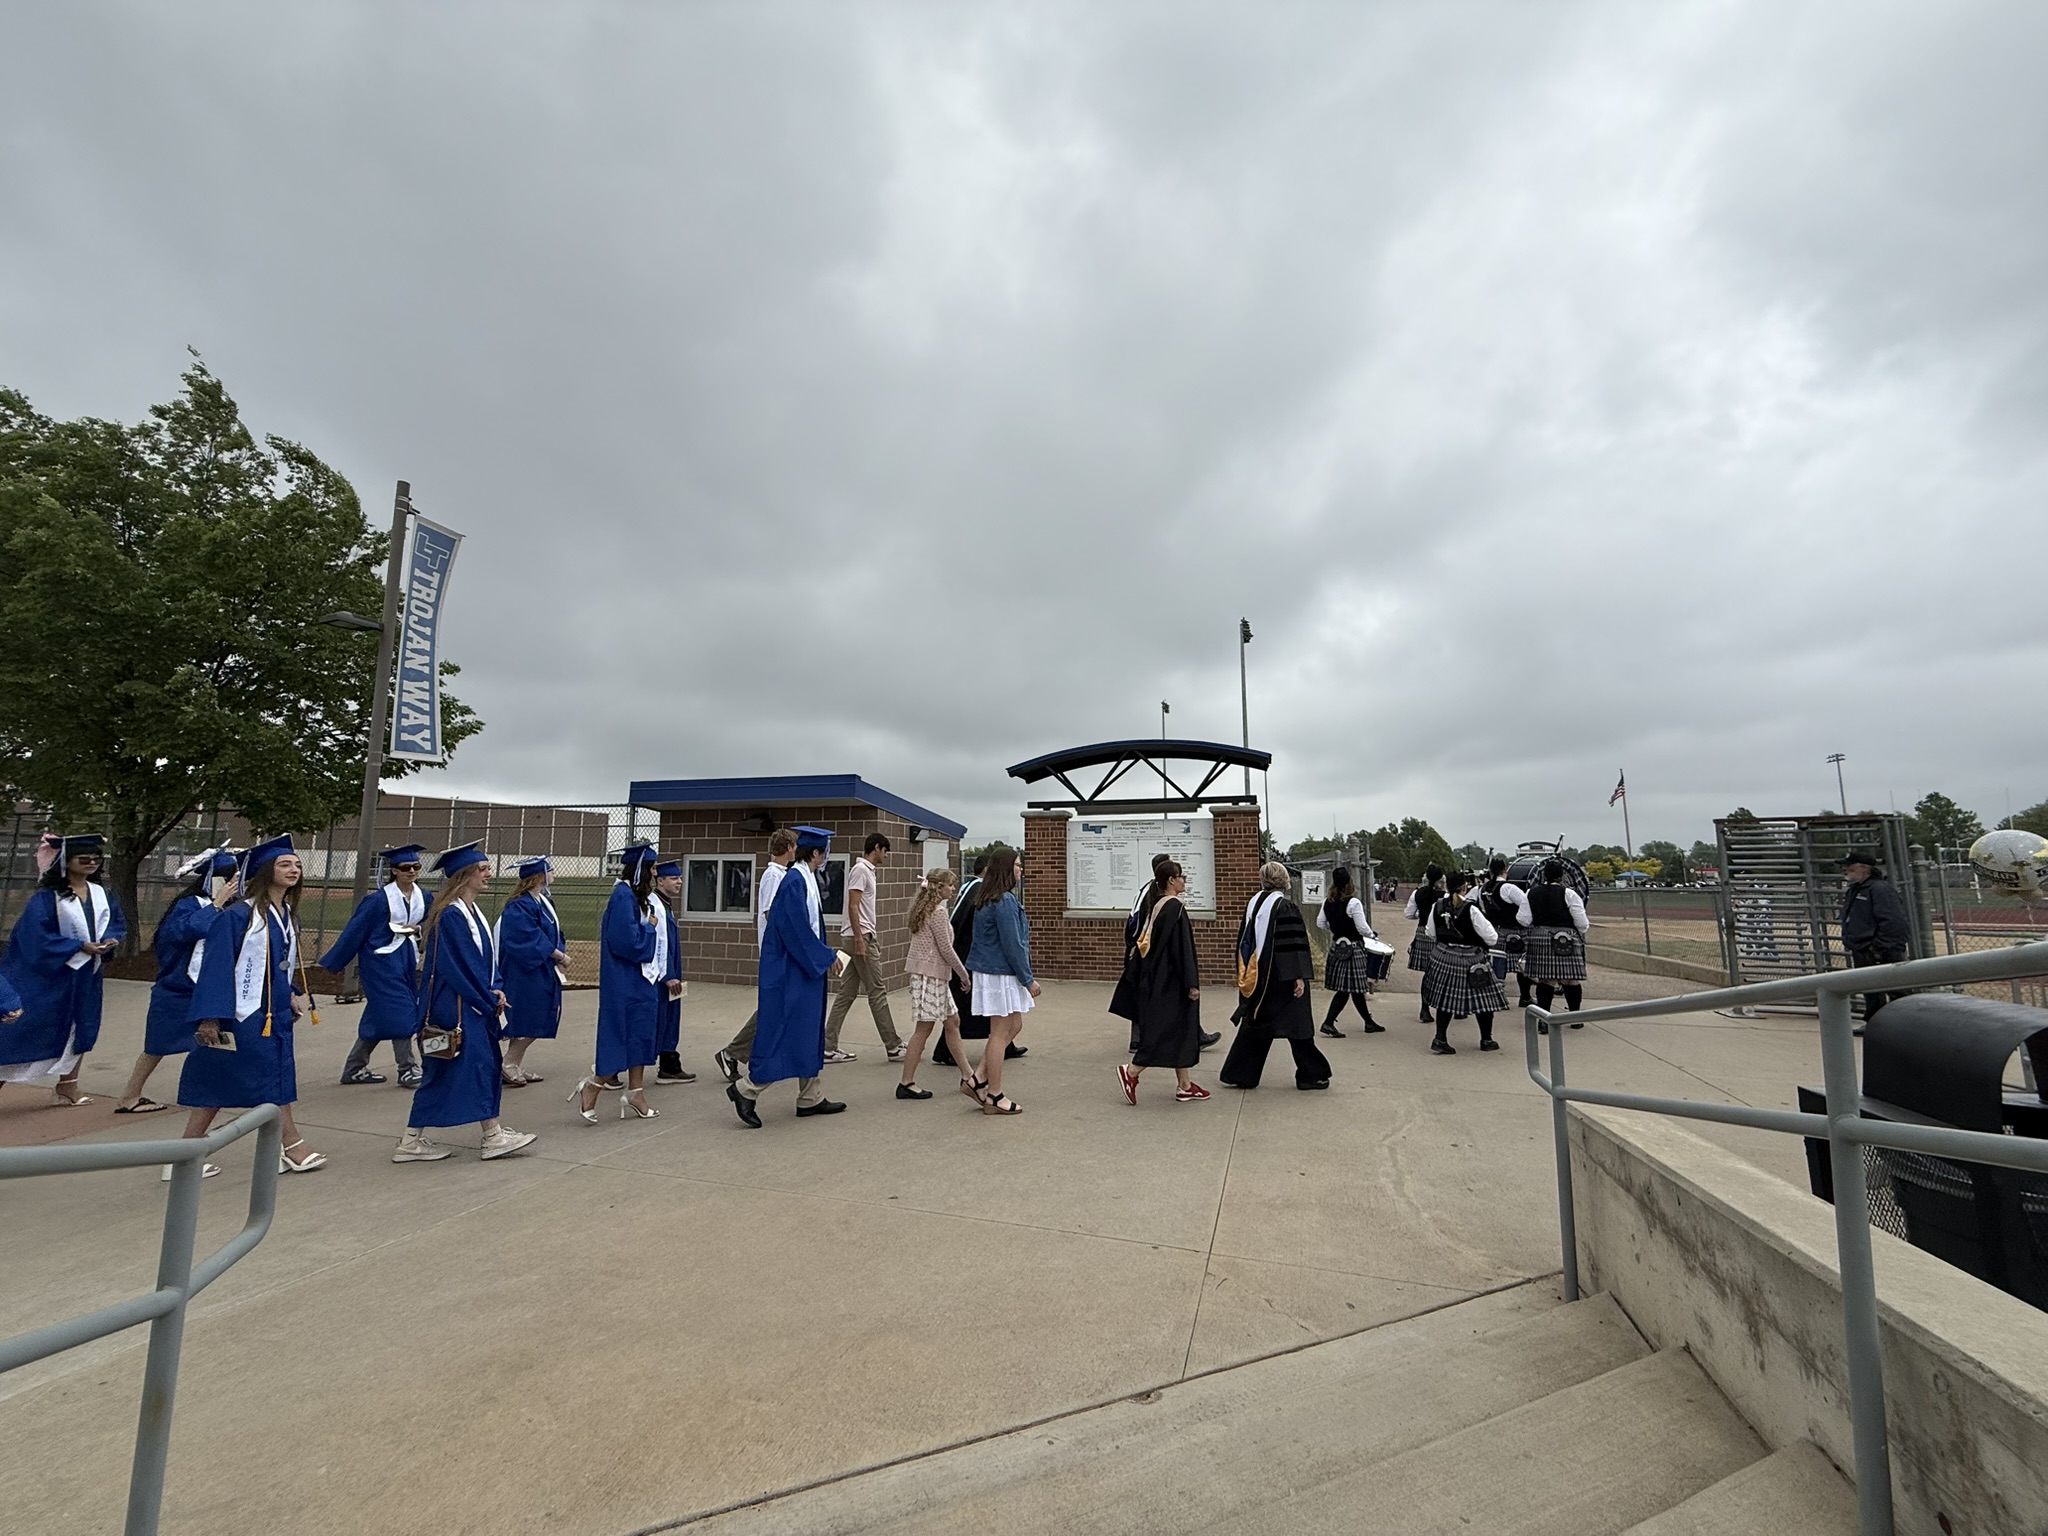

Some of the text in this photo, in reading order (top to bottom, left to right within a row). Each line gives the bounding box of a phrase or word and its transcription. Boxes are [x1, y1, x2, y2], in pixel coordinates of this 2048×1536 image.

[400, 568, 438, 750] TROJAN WAY
[242, 957, 252, 999] LONGMONT
